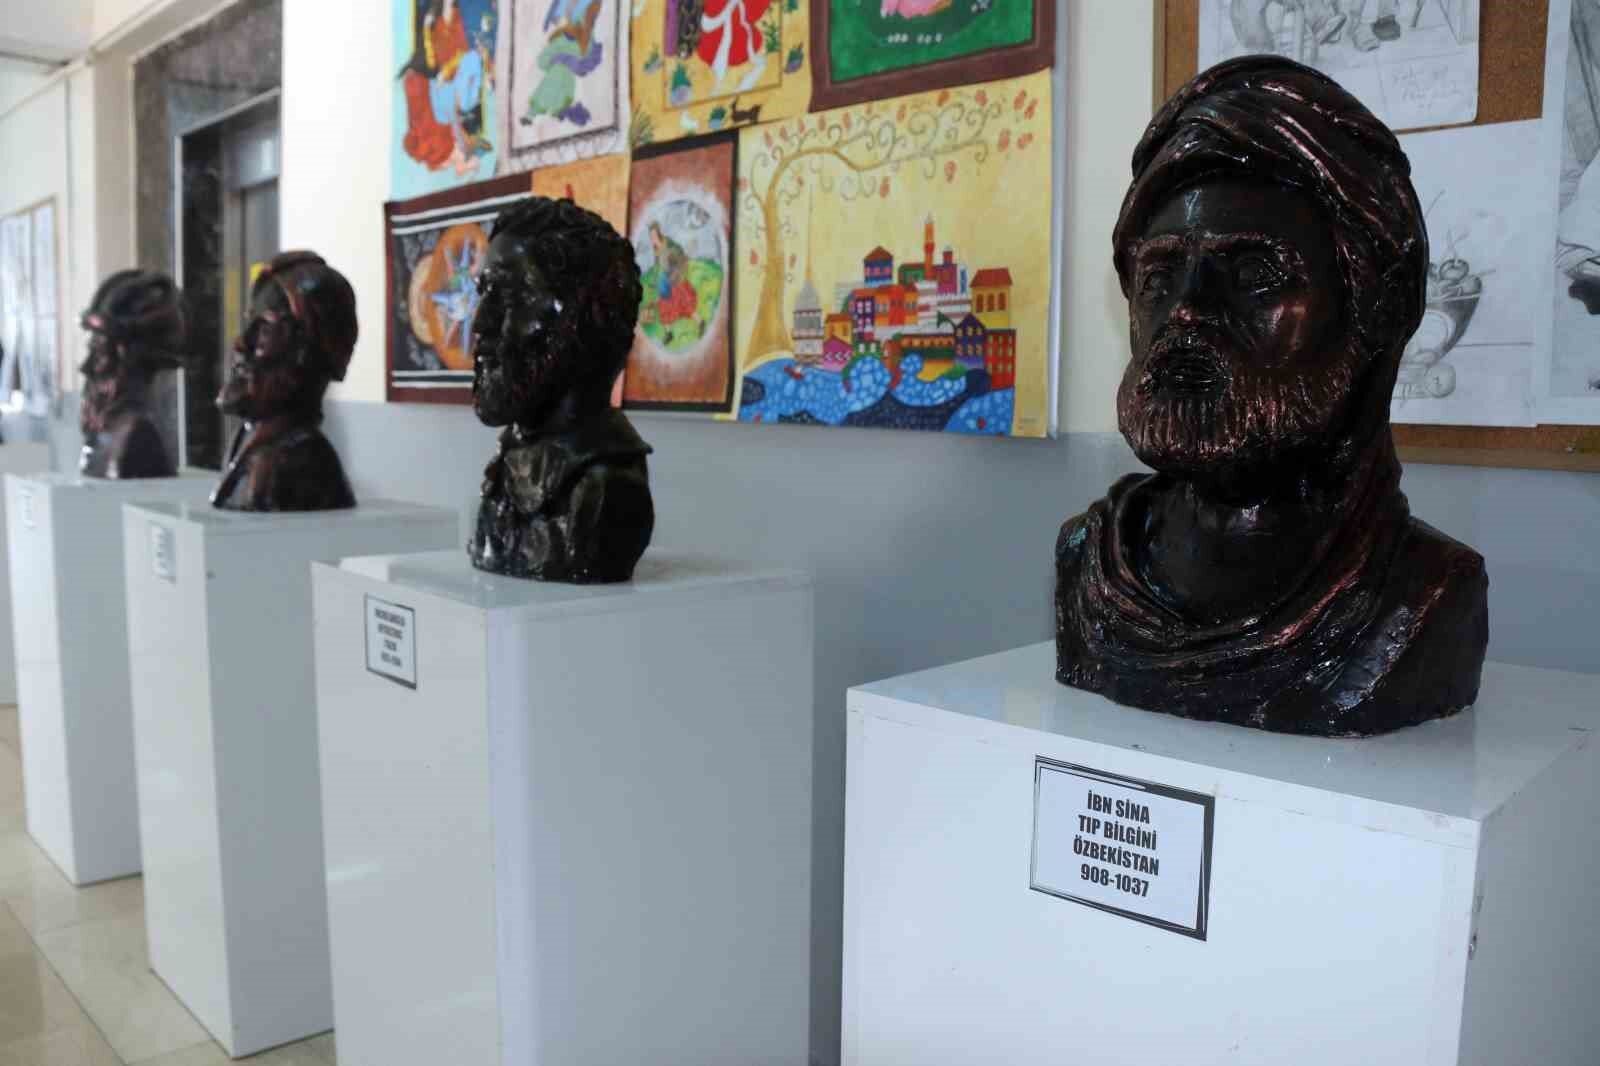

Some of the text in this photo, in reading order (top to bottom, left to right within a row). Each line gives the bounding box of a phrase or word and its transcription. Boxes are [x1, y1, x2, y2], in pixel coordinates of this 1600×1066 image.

[1087, 790, 1150, 824] İBN SİNA
[1078, 814, 1157, 850] TIP BİLGİNİ
[1073, 834, 1159, 876] ÖZBEKİSTAN
[1080, 863, 1150, 898] 908-1037
